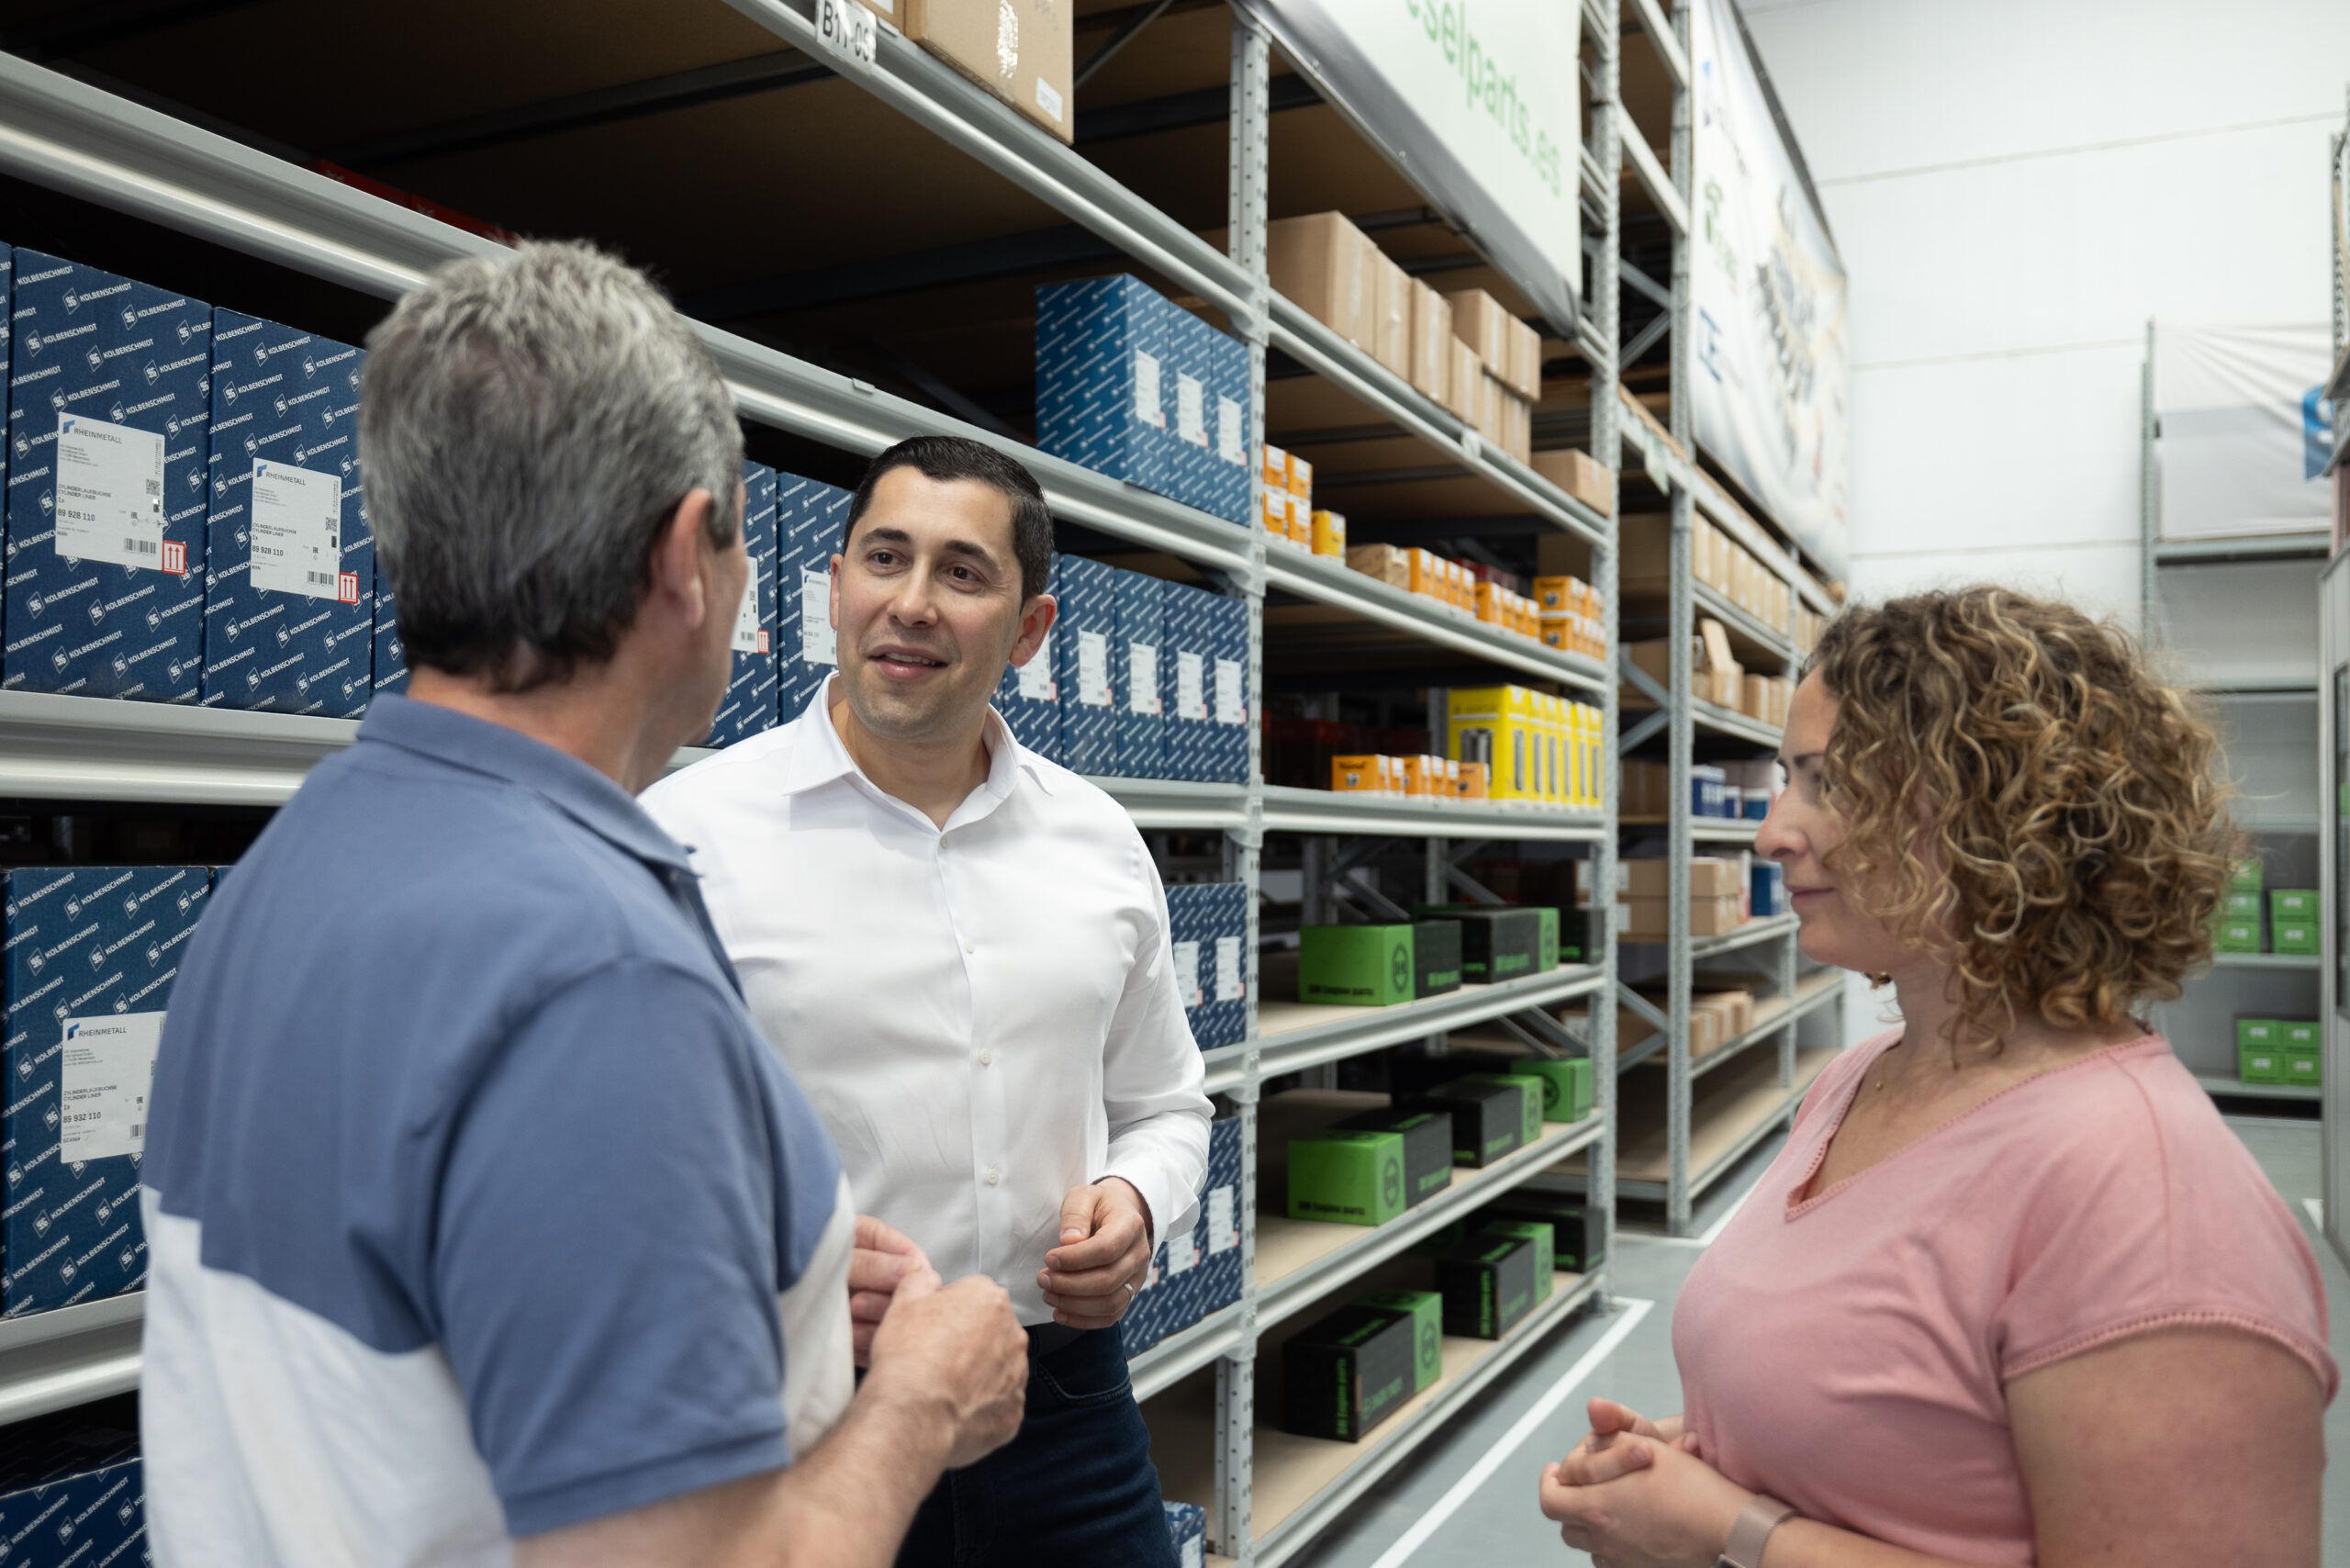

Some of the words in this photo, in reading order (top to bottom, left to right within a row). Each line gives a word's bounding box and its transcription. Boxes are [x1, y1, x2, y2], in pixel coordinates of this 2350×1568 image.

[17, 265, 74, 286] KOLBENSCHMIDT
[80, 283, 132, 302] KOLBENSCHMIDT
[137, 298, 186, 318] KOLBENSCHMIDT
[43, 323, 97, 344] KOLBENSCHMIDT
[216, 322, 263, 342] KOLBENSCHMIDT
[103, 338, 154, 359] KOLBENSCHMIDT
[268, 336, 311, 355] KOLBENSCHMIDT
[160, 353, 207, 373] KOLBENSCHMIDT
[316, 349, 356, 368] KOLBENSCHMIDT
[11, 365, 62, 386] LBENSCHMIDT
[238, 374, 283, 394] KOLBENSCHMIDT
[67, 379, 120, 402] KOLBENSCHMIDT
[287, 386, 330, 406] KOLBENSCHMIDT
[126, 393, 175, 414] KOLBENSCHMIDT
[181, 412, 209, 427] KOLBENSC
[209, 413, 253, 433] OLBENSCHMIDT
[74, 428, 122, 444] RHEINMETALL
[258, 424, 303, 445] KOLBENSCHMIDT
[307, 435, 349, 455] KOLBENSCHMIDT
[164, 446, 196, 464] ENSCHMIDT
[228, 471, 253, 486] KOLBENS
[265, 471, 306, 486] RHEINMETALL
[57, 509, 66, 517] 89
[68, 510, 81, 519] 928
[83, 512, 95, 521] 110
[207, 505, 243, 526] BENSCHMIDT
[261, 546, 271, 554] 928
[274, 548, 284, 556] 110
[6, 568, 38, 588] SCHMIDT
[44, 577, 99, 605] KOLBENSCHMIDT
[105, 585, 156, 611] KOLBENSCHMIDT
[205, 597, 235, 616] NSCHMIDT
[240, 604, 285, 630] KOLBENSCHMIDT
[290, 610, 331, 635] KOLBENSCHMIDT
[336, 618, 373, 641] KOLBENSCHMID
[375, 619, 397, 634] SCHMIDT
[6, 623, 63, 653] KOLBENSCHMIDT
[69, 630, 123, 659] KOLBENSCHMIDT
[128, 637, 178, 665] KOLBENSCHMIDT
[208, 646, 255, 674] KOLBENSCHMIDT
[260, 653, 305, 678] KOLBENSCHMIDT
[309, 657, 350, 683] KOLBENSCHMIDT
[18, 872, 75, 907] KOLBENSCHMIDT
[81, 871, 134, 905] KOLBENSCHMIDT
[140, 870, 186, 902] KOLBENSCHMIDT
[45, 923, 100, 959] KOLBENSCHMIDT
[106, 920, 156, 955] KOLBENSCHMIDT
[8, 976, 64, 1013] KOLBENSCHMIDT
[70, 971, 124, 1009] KOLBENSCHMIDT
[129, 968, 177, 1003] KOLBENSCHMIDT
[78, 1026, 127, 1037] RHEINMETALL
[73, 1114, 86, 1122] 932
[89, 1111, 101, 1120] 110
[51, 1177, 106, 1219] KOLBENSCHMIDT
[111, 1182, 143, 1208] KOLBENSC
[76, 1223, 129, 1266] KOLBENSCHMIDT
[13, 1235, 71, 1280] KOLBENSCHMIDT
